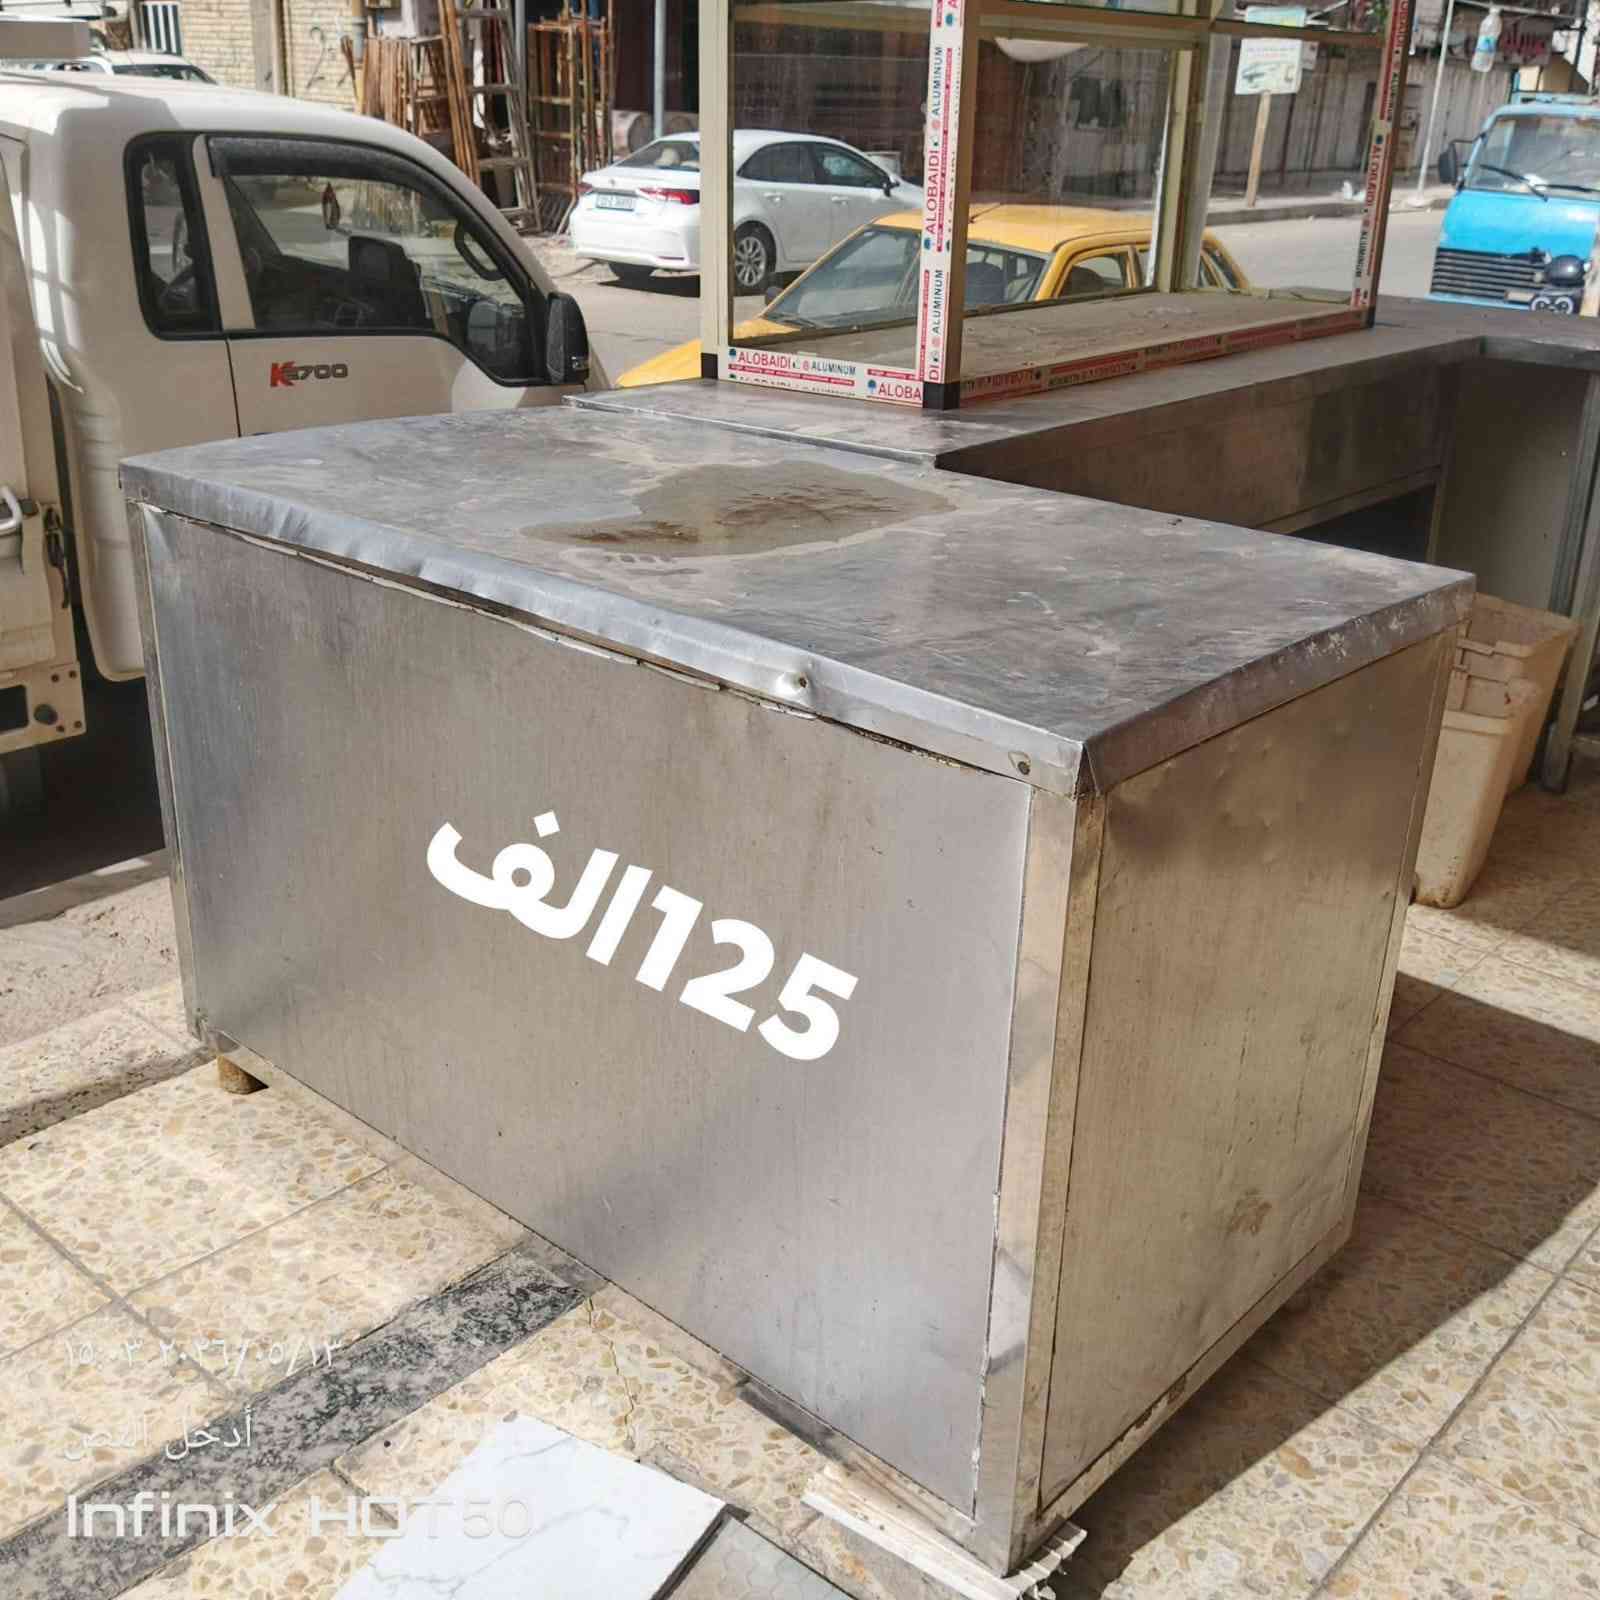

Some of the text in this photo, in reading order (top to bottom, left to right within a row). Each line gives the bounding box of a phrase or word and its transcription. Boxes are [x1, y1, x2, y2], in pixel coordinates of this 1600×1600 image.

[926, 47, 943, 234] ALOBAIDI ALUMINUM
[932, 270, 944, 334] ALUMINUM
[738, 352, 791, 369] ALOBAIDI
[811, 360, 856, 376] ALUMINUM
[878, 383, 921, 400] ALOBA
